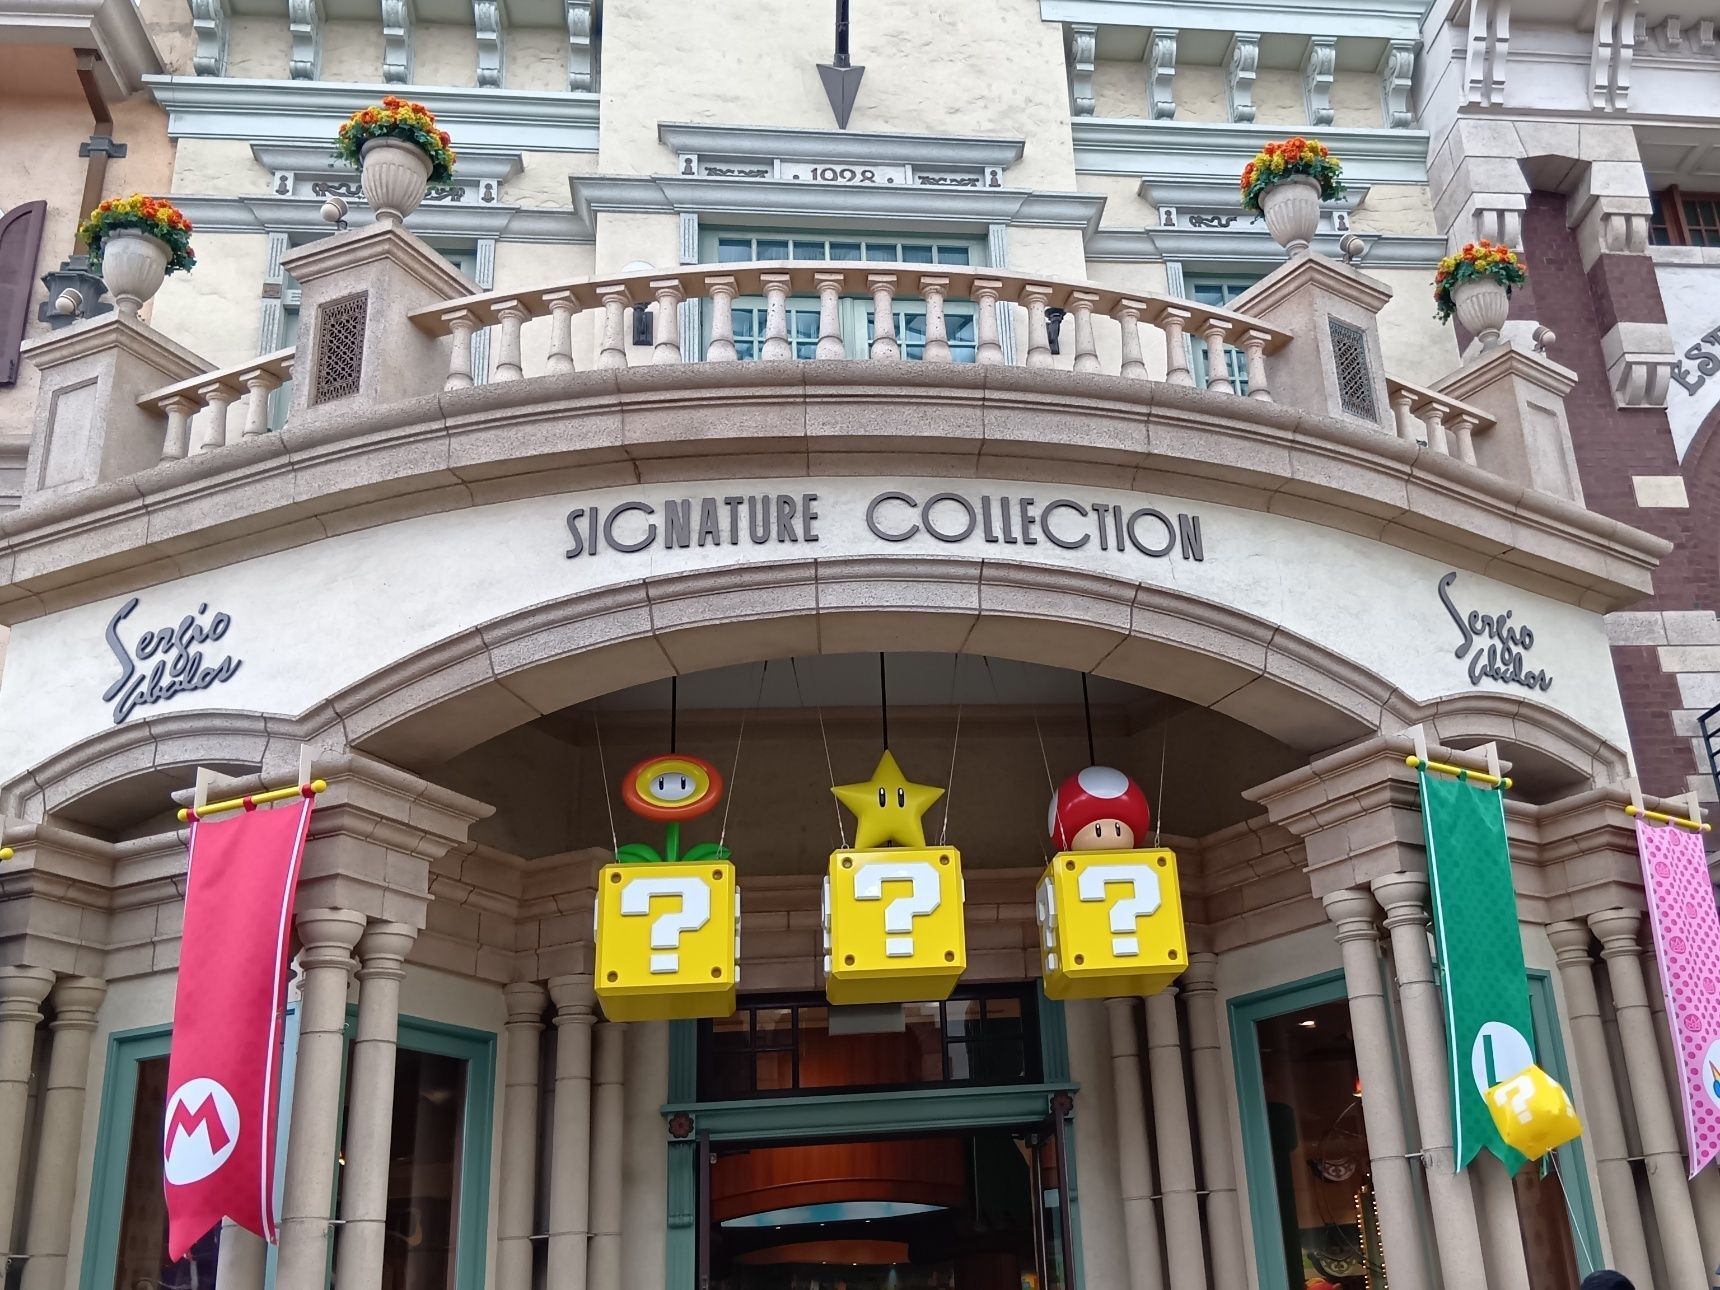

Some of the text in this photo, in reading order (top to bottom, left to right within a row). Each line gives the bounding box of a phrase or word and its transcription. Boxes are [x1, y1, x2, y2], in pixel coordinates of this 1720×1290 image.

[810, 167, 876, 183] 1928
[566, 491, 1204, 561] SIGNATURE COLLECTION
[102, 597, 231, 702] Sergio
[1438, 571, 1534, 666] Sergio
[164, 1092, 231, 1163] M
